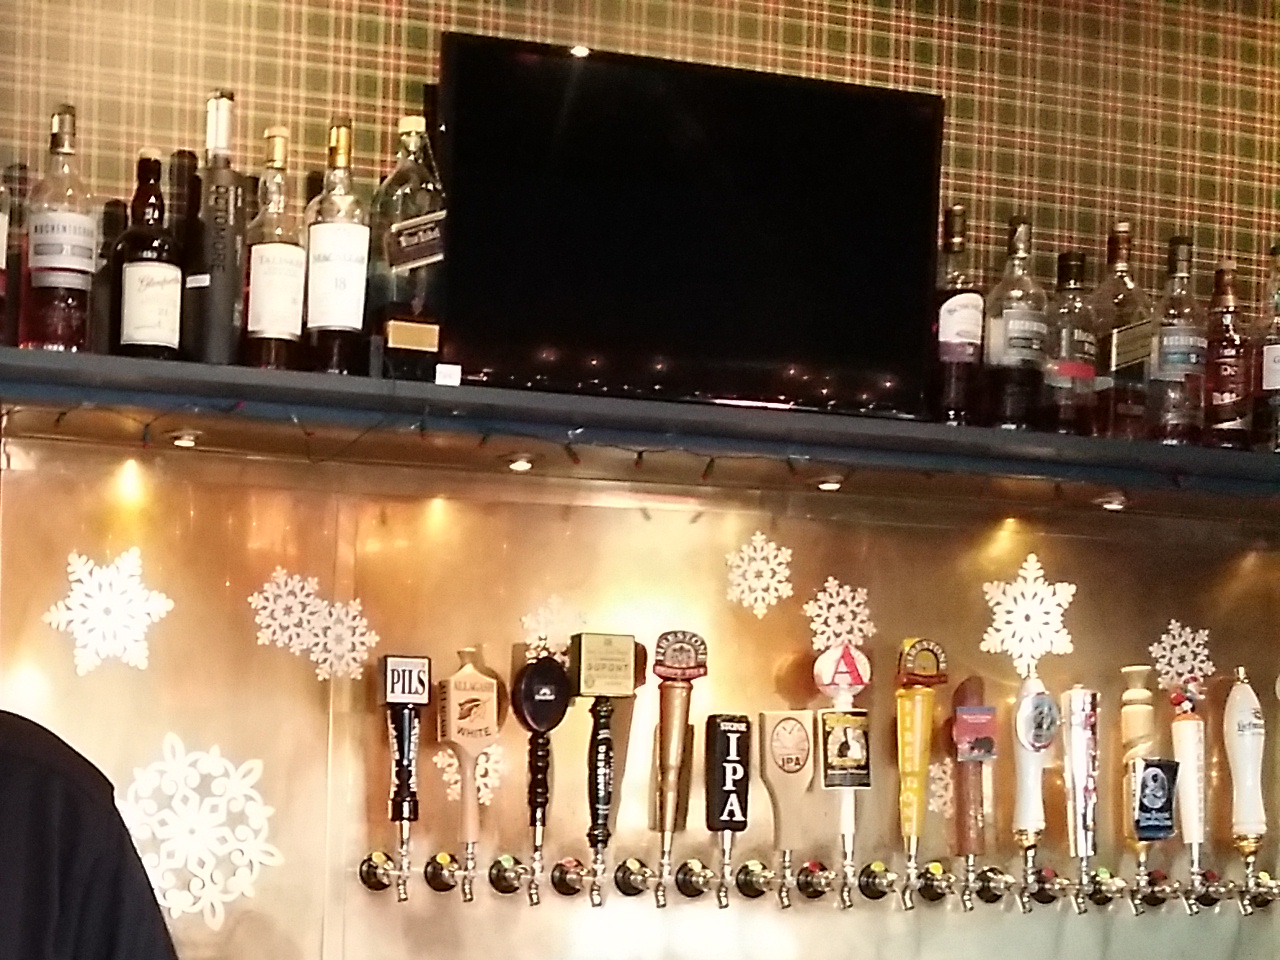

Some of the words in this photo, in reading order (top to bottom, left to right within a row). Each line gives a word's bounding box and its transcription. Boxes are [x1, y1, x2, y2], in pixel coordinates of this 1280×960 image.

[655, 631, 708, 663] FIRESTONE
[390, 669, 426, 696] PILS
[457, 726, 492, 737] WHITE
[781, 756, 801, 768] IPA
[720, 732, 746, 822] IPA
